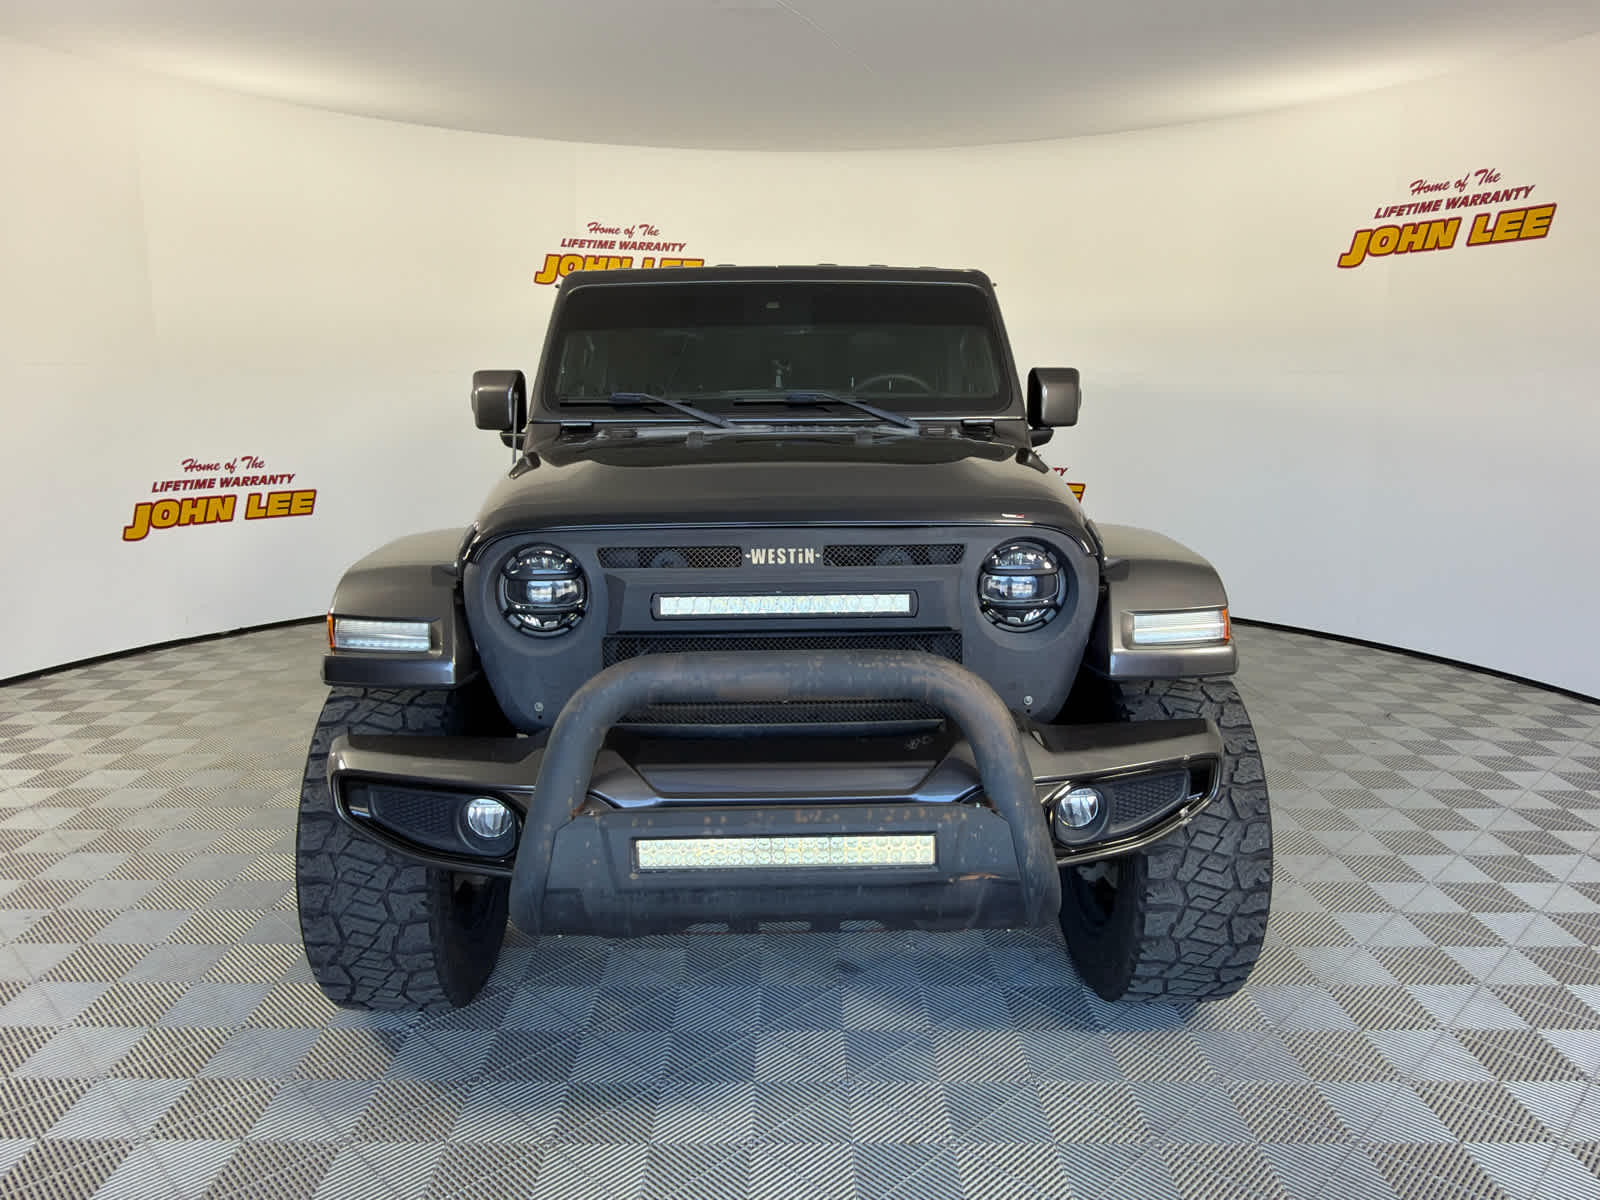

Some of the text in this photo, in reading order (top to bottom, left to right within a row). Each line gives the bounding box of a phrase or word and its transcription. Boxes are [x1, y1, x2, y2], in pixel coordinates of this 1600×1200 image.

[1410, 168, 1501, 195] Home of The
[1374, 185, 1536, 219] LIFETIME WARRANTY
[587, 221, 660, 238] Home of The
[1337, 203, 1557, 268] JOHN LEE
[561, 238, 686, 252] LIFETIME WARRANTY
[181, 456, 265, 473] Home of The
[152, 474, 295, 493] LIFETIME WARRANTY
[123, 489, 317, 541] JOHN LEE
